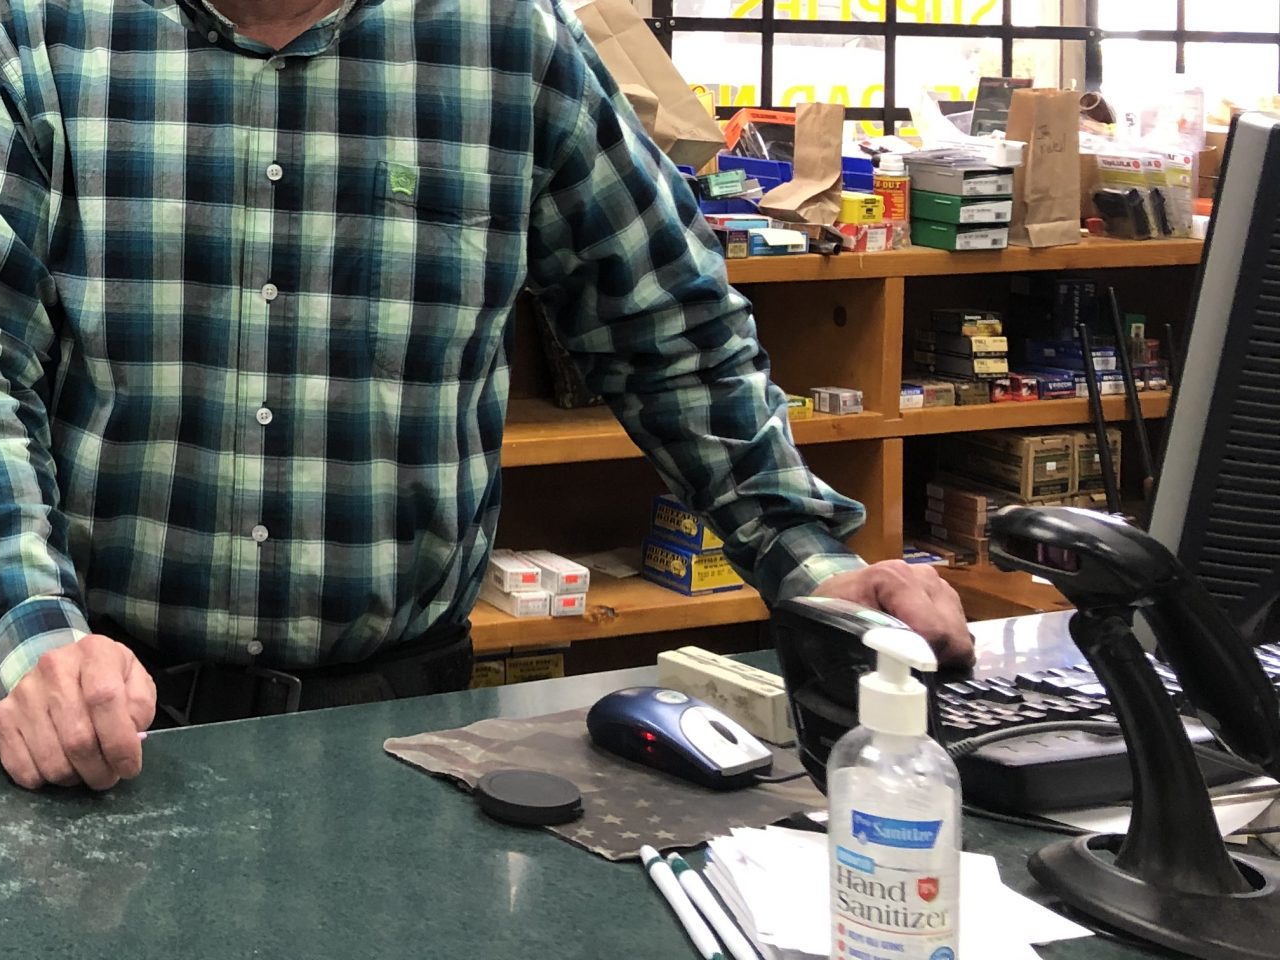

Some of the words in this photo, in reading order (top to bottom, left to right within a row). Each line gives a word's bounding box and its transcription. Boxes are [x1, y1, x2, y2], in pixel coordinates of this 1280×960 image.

[656, 511, 681, 527] BORE
[657, 503, 699, 524] BUFFALO
[836, 864, 906, 904] Hand
[837, 891, 950, 929] Sanitizer
